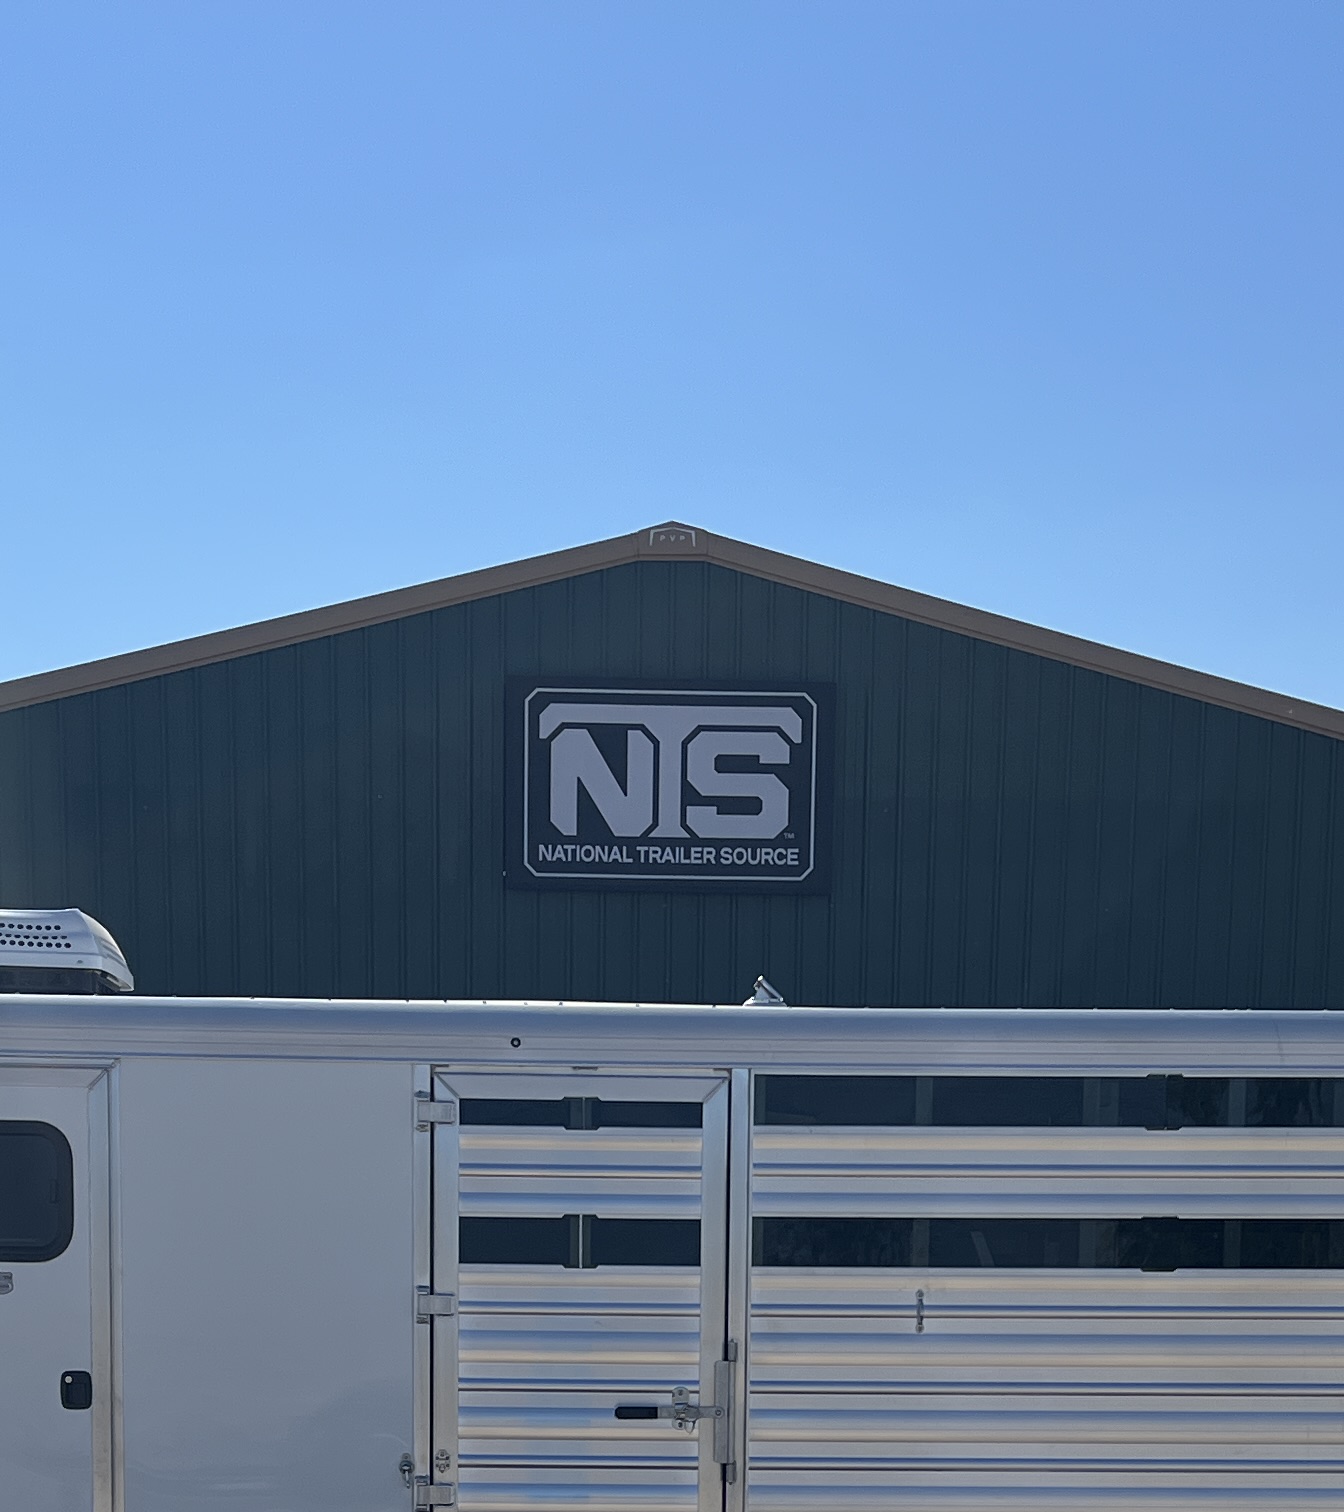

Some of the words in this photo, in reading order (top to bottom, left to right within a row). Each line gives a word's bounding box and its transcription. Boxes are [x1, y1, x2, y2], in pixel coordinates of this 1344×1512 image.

[539, 703, 802, 839] NTS
[538, 844, 633, 863] NATIONAL
[636, 846, 716, 864] TRAILER
[720, 847, 799, 866] SOURCE
